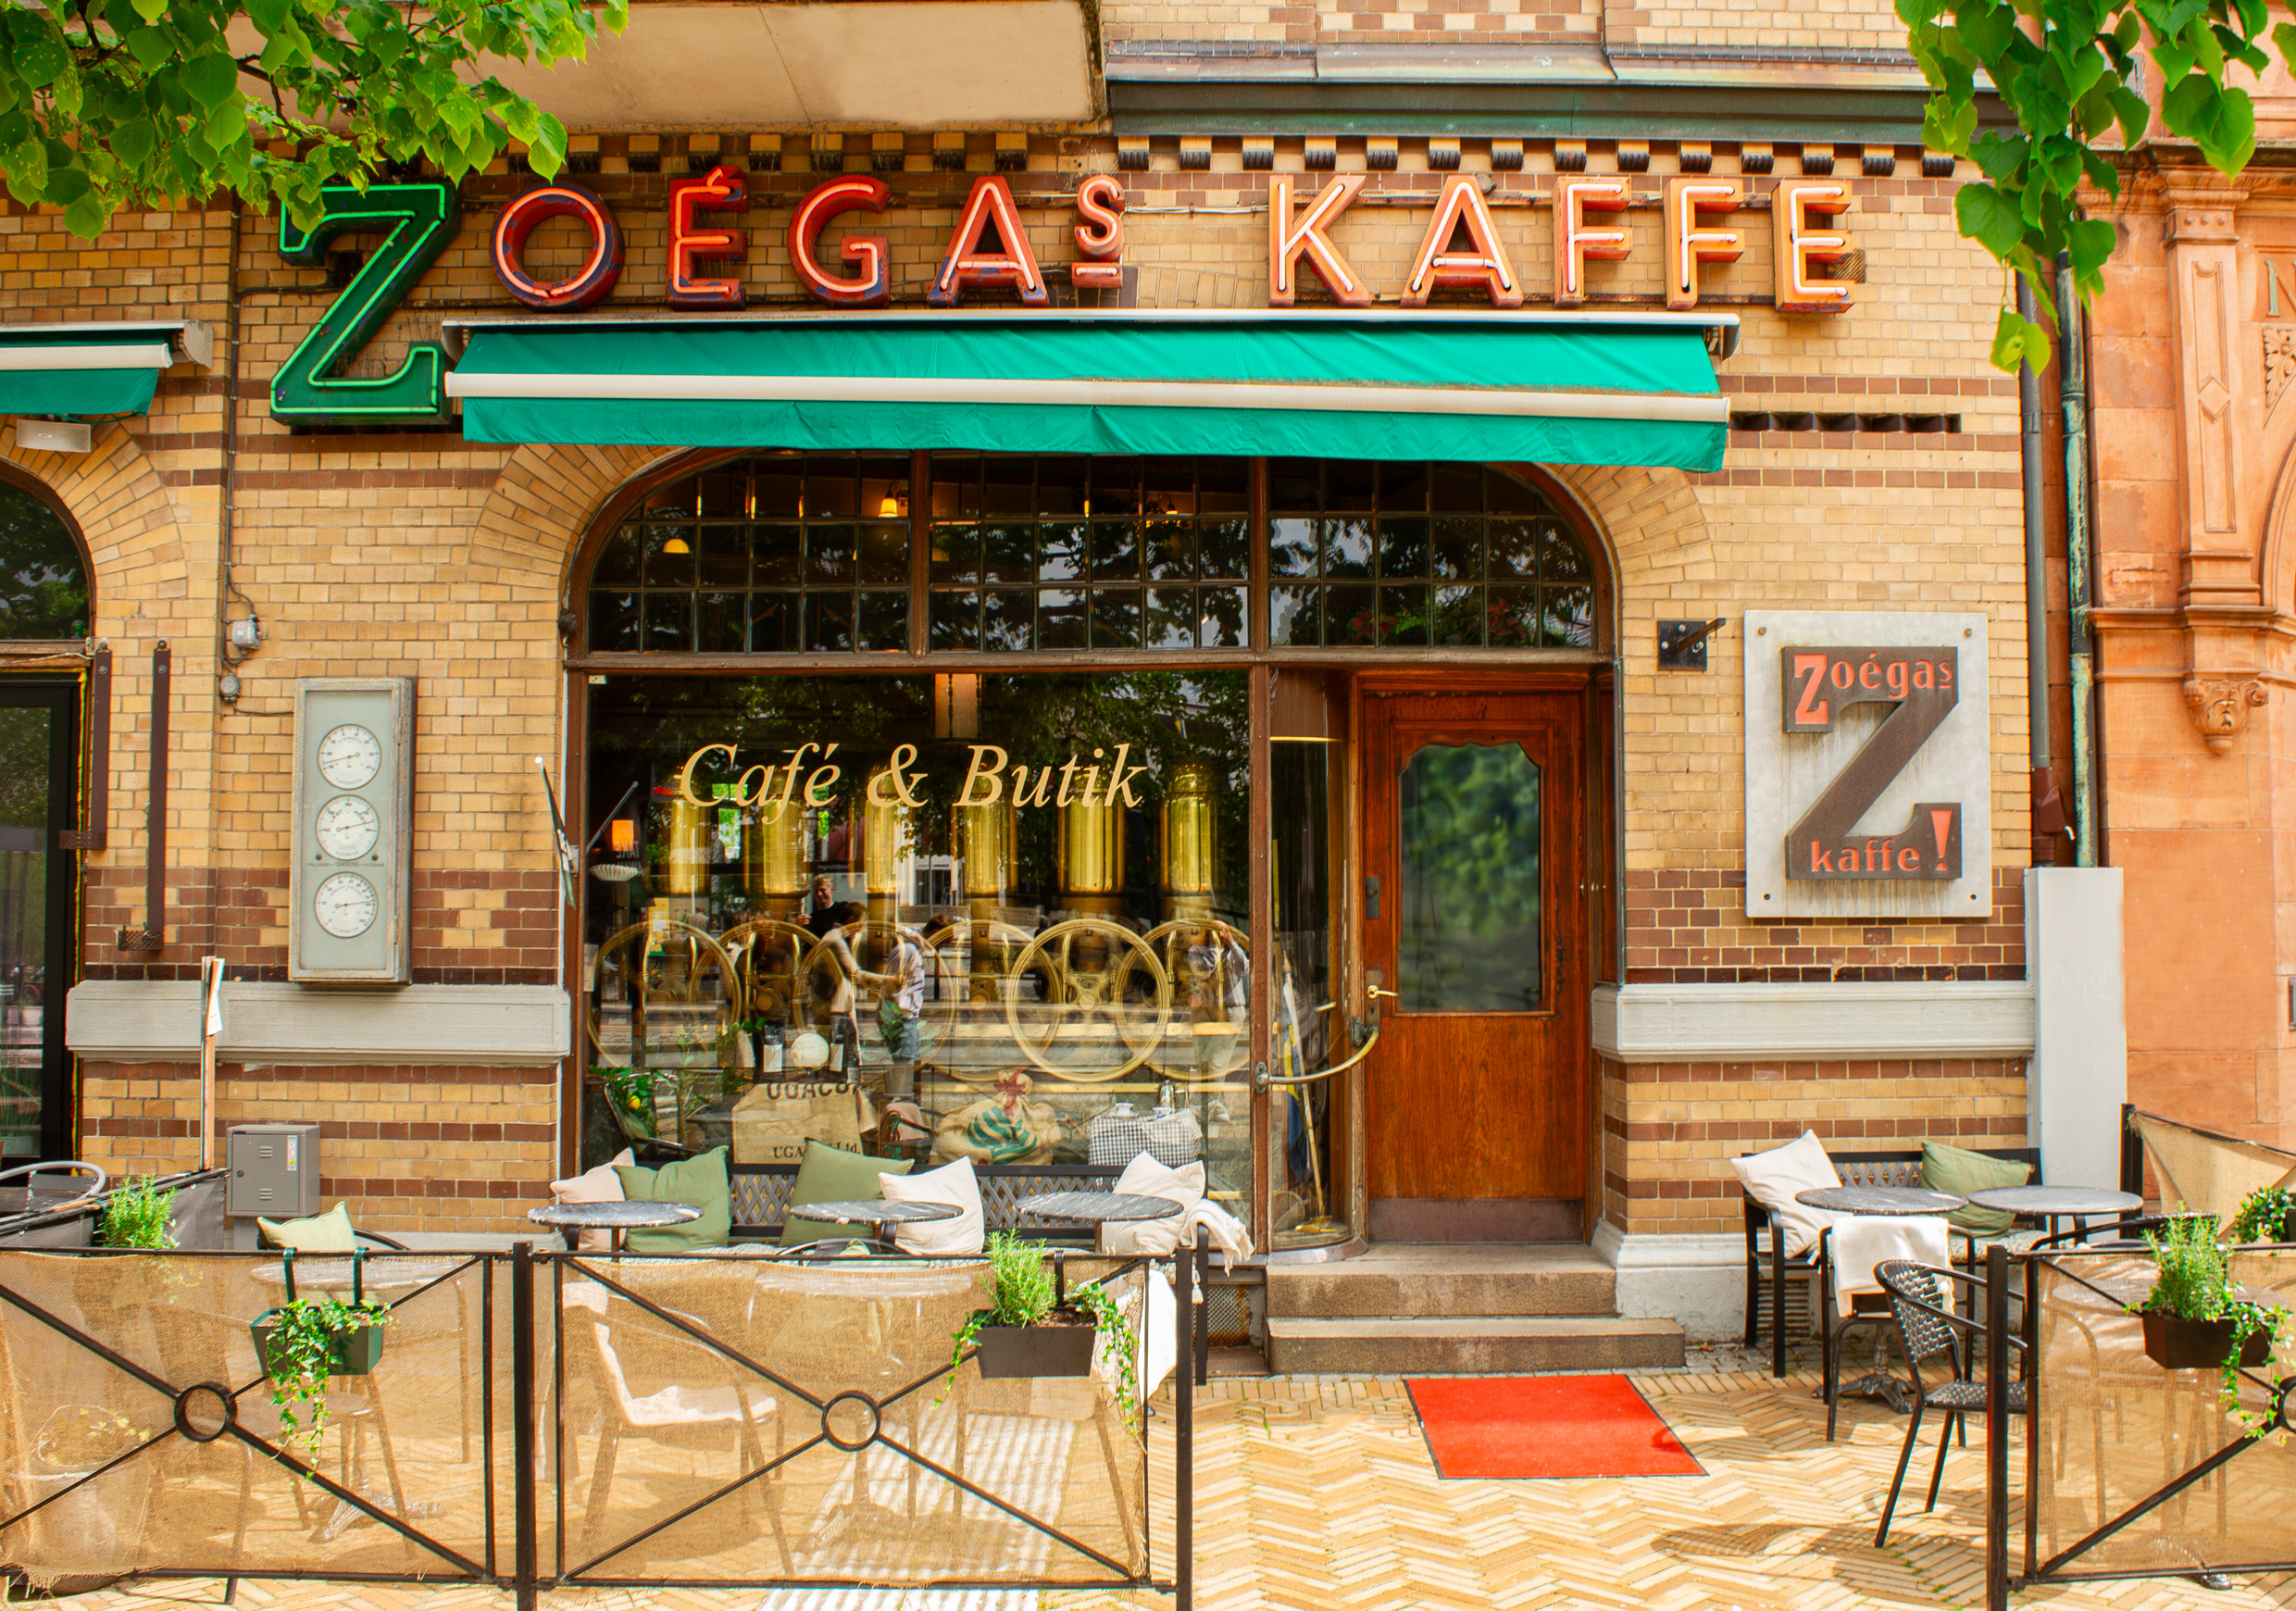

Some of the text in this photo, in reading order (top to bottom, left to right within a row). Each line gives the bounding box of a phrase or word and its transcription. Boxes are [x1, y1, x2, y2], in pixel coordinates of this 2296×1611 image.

[1268, 173, 1854, 314] KAFFE
[1793, 652, 1953, 725] Zoégas
[680, 741, 1150, 825] Café & Butik
